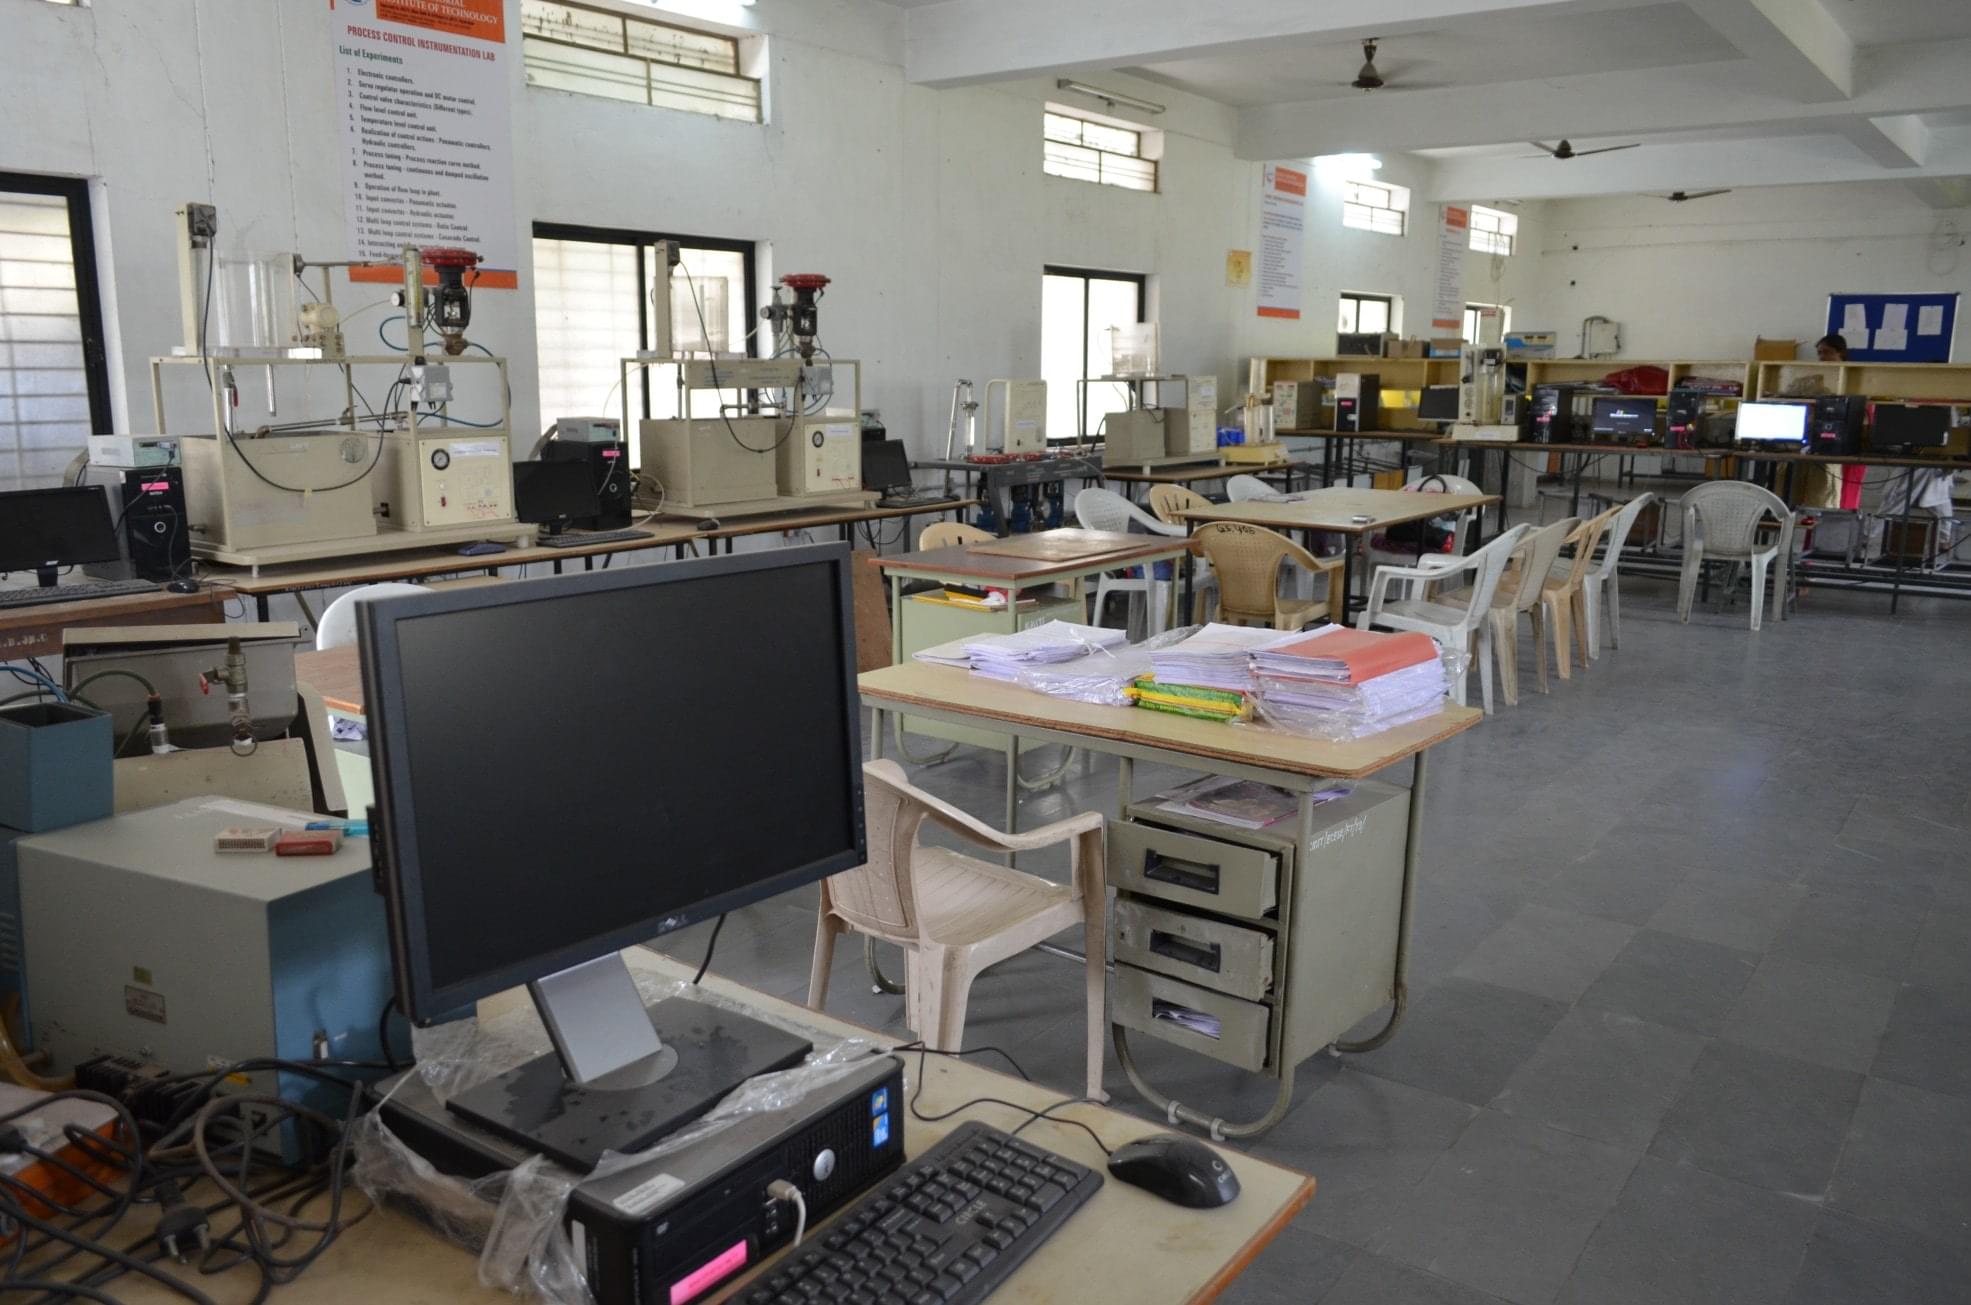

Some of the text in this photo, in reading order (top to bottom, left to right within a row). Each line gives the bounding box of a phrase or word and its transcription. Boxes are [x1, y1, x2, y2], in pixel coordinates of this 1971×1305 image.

[428, 2, 440, 13] OF
[440, 5, 498, 24] TECHNOLOGY
[347, 25, 496, 61] PROCESS CONTROL INSTRUMENTATION LAB
[339, 45, 403, 65] List of Experiments
[358, 68, 384, 80] Electronic
[360, 92, 378, 101] Control
[380, 96, 392, 104] valve
[400, 87, 423, 97] operation
[360, 104, 372, 112] Flow
[374, 105, 386, 114] level
[388, 108, 405, 116] control
[361, 115, 393, 127] Temperature
[394, 118, 406, 128] level
[408, 122, 425, 130] control
[362, 138, 386, 148] Hydraulic
[398, 132, 415, 140] control
[439, 137, 464, 147] Pneumatic
[363, 149, 384, 158] Process
[385, 152, 401, 162] tuning
[406, 154, 426, 164] Process
[427, 158, 447, 166] reaction
[364, 160, 384, 170] Process
[386, 164, 402, 173] tuning
[407, 166, 434, 176] continuous
[445, 170, 464, 180] damped
[365, 182, 390, 192] Operation
[410, 187, 420, 196] loop
[366, 194, 380, 204] Input
[409, 198, 434, 208] Pneumatic
[366, 206, 380, 215] Input
[410, 210, 432, 218] Hydraulic
[366, 217, 380, 225] Multi
[381, 218, 392, 228] loop
[393, 219, 410, 227] control
[412, 221, 432, 230] systems
[368, 228, 382, 236] Multi
[383, 230, 394, 238] loop
[395, 230, 412, 238] control
[414, 232, 434, 240] systems
